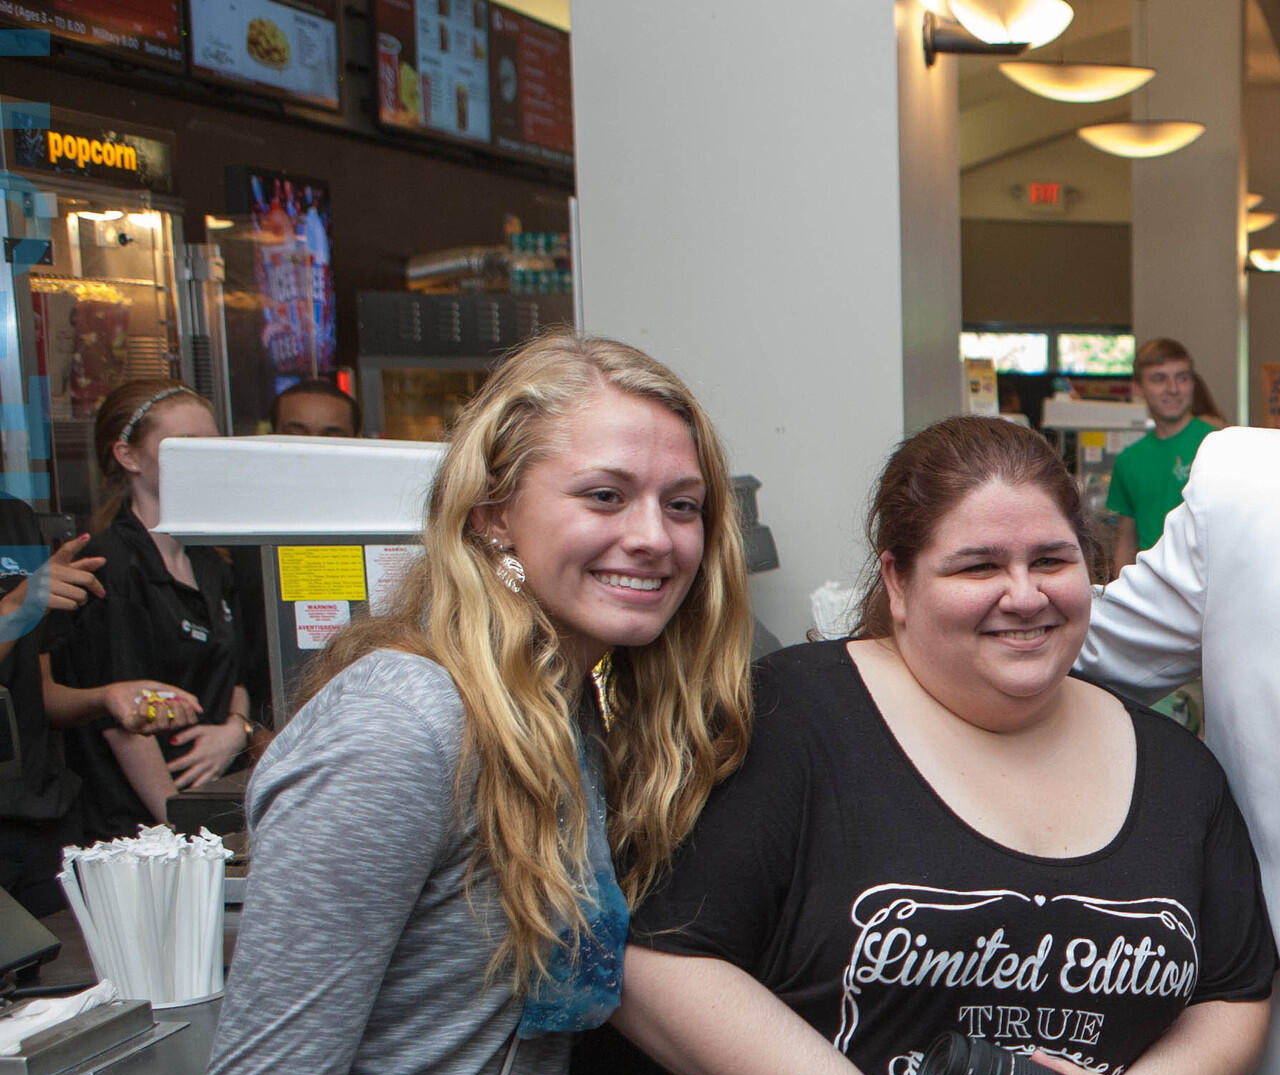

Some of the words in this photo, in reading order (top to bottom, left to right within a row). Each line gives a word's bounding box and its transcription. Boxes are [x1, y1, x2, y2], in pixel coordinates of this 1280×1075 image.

[47, 130, 137, 172] popcorn
[857, 926, 1053, 993] Limited
[1060, 935, 1196, 998] Edition
[958, 1005, 1105, 1046] TRUE
